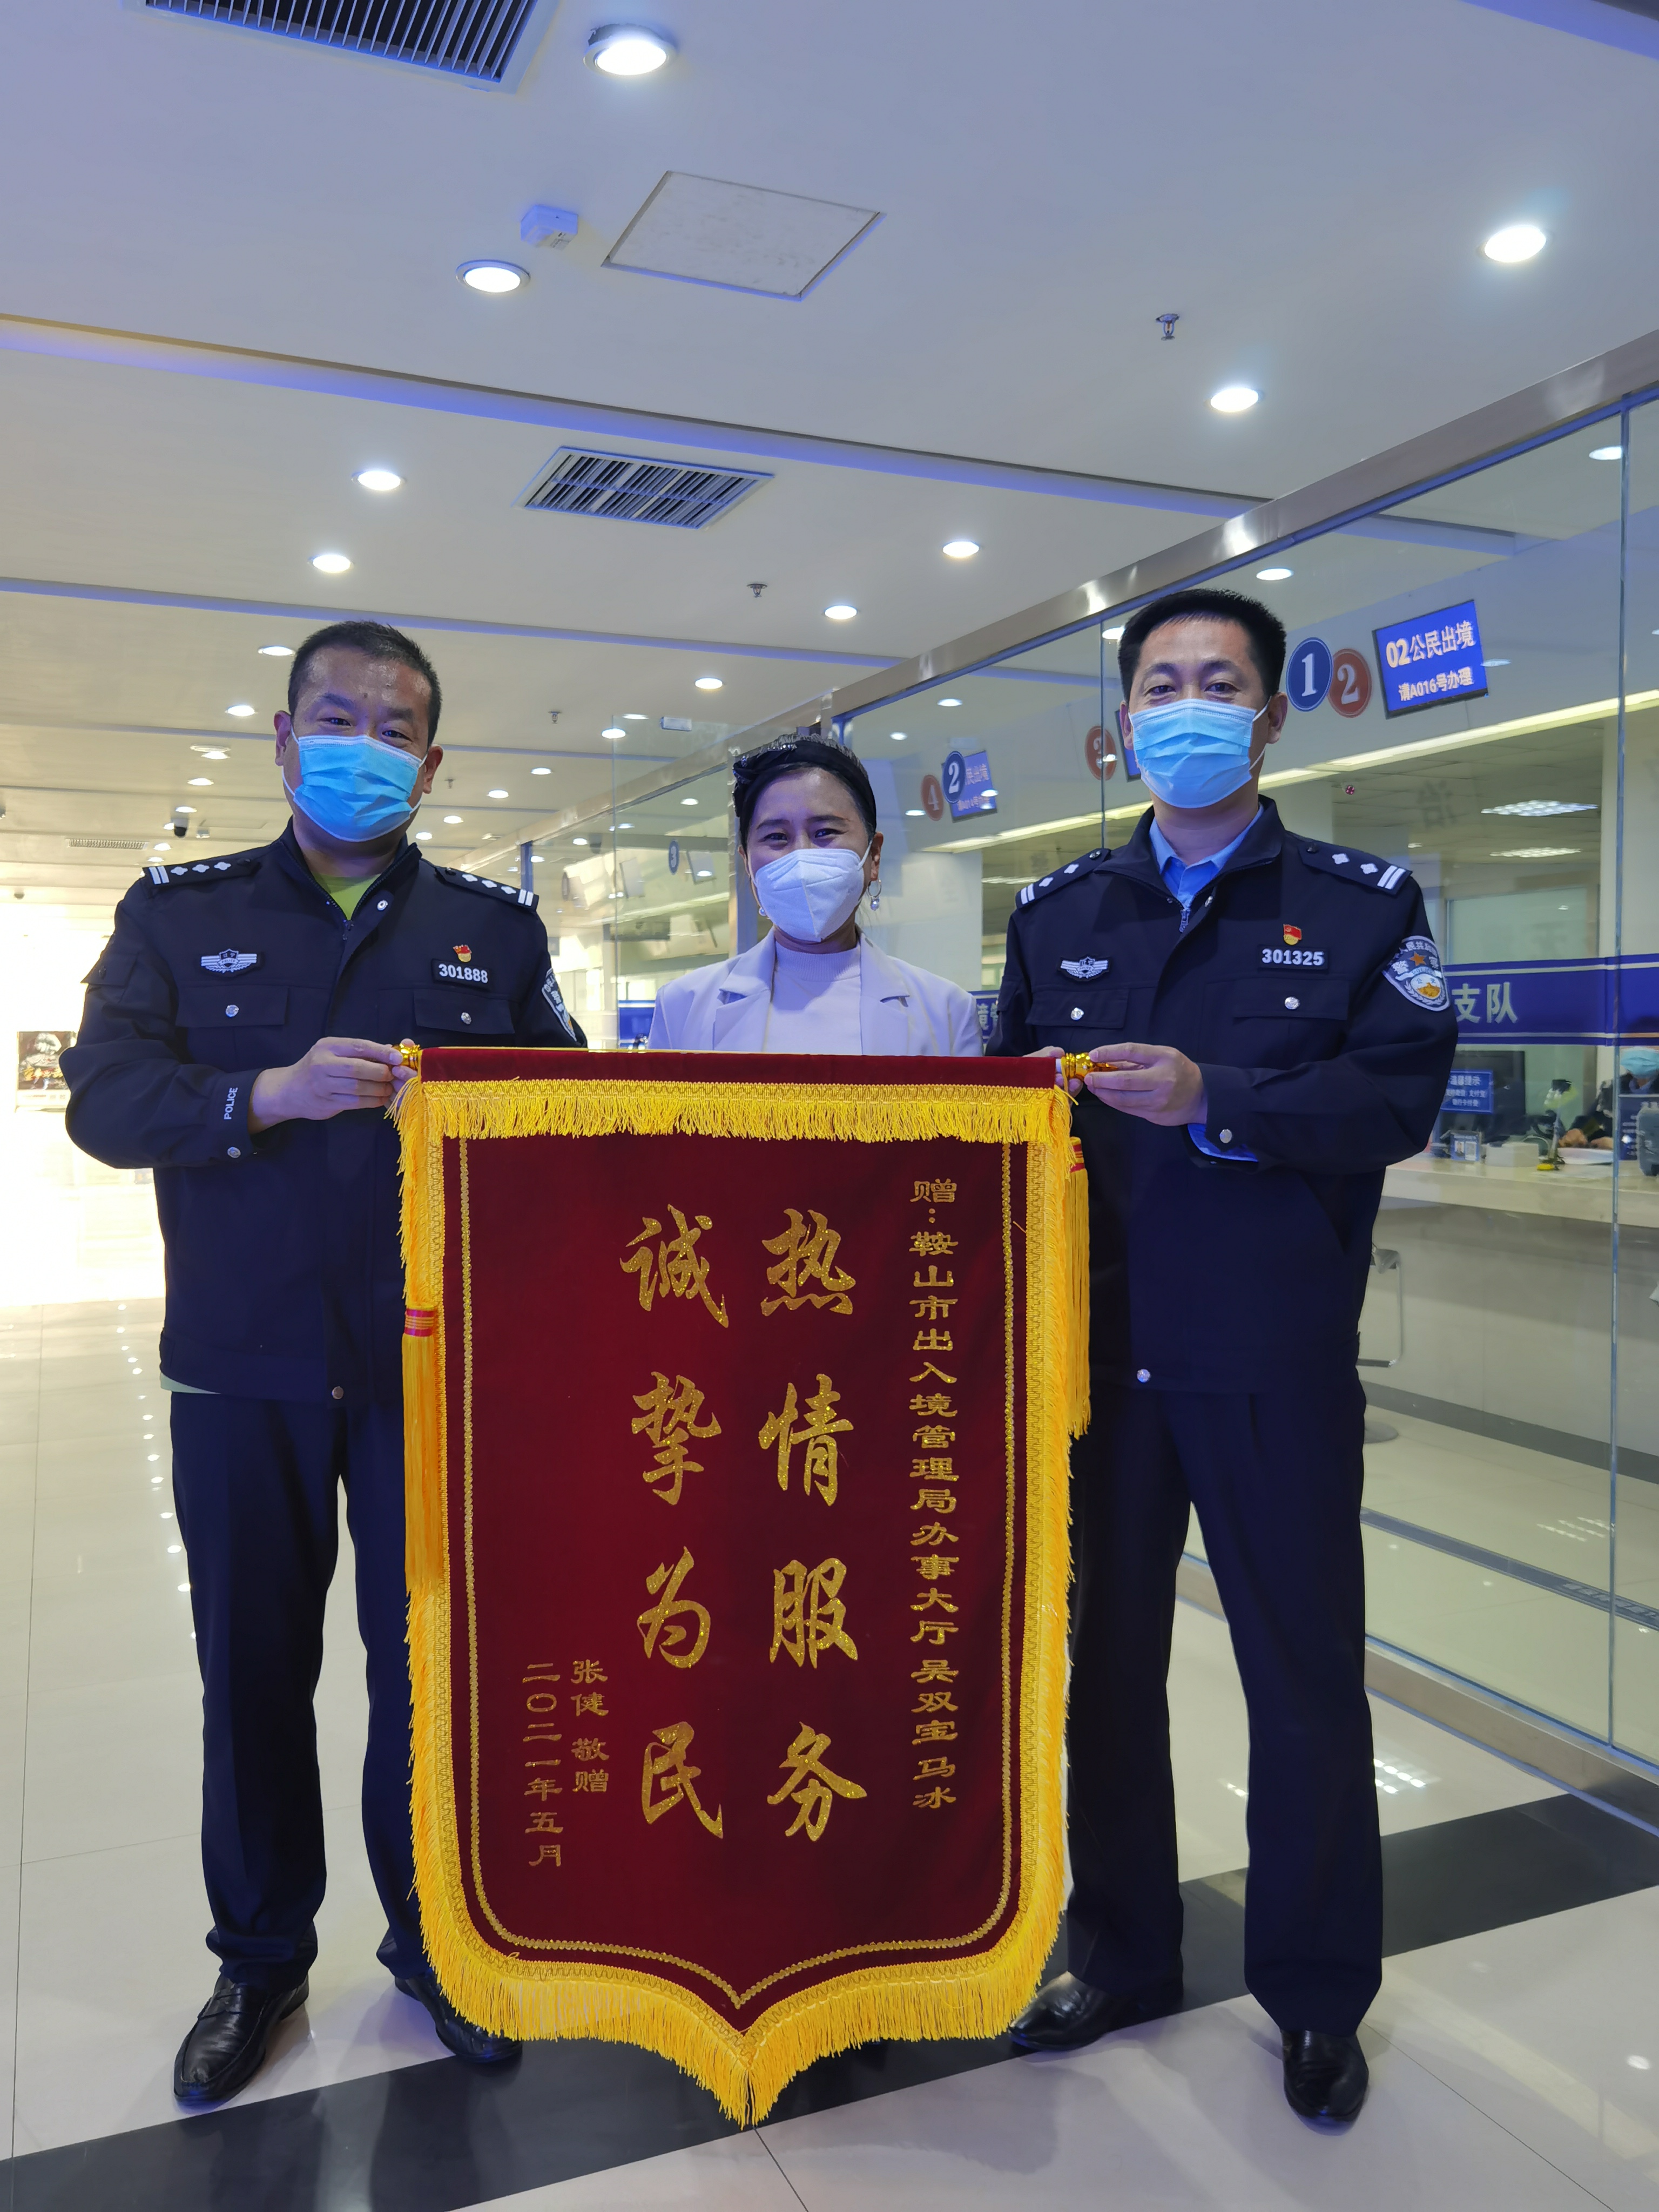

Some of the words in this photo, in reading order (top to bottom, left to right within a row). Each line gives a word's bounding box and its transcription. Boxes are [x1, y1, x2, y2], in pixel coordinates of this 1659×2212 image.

[1386, 620, 1476, 669] 02公民出境
[1301, 653, 1317, 697] 1
[1338, 664, 1360, 704] 2
[1398, 666, 1474, 702] 请A016号办理
[948, 762, 960, 794] 2
[928, 785, 940, 811] 4
[438, 963, 489, 983] 301888
[1262, 948, 1325, 966] 301325
[1451, 982, 1518, 1024] 支队
[224, 1087, 238, 1120] POLICE
[619, 1203, 729, 1839] 诚挚为民
[758, 1208, 868, 1842] 热情服务
